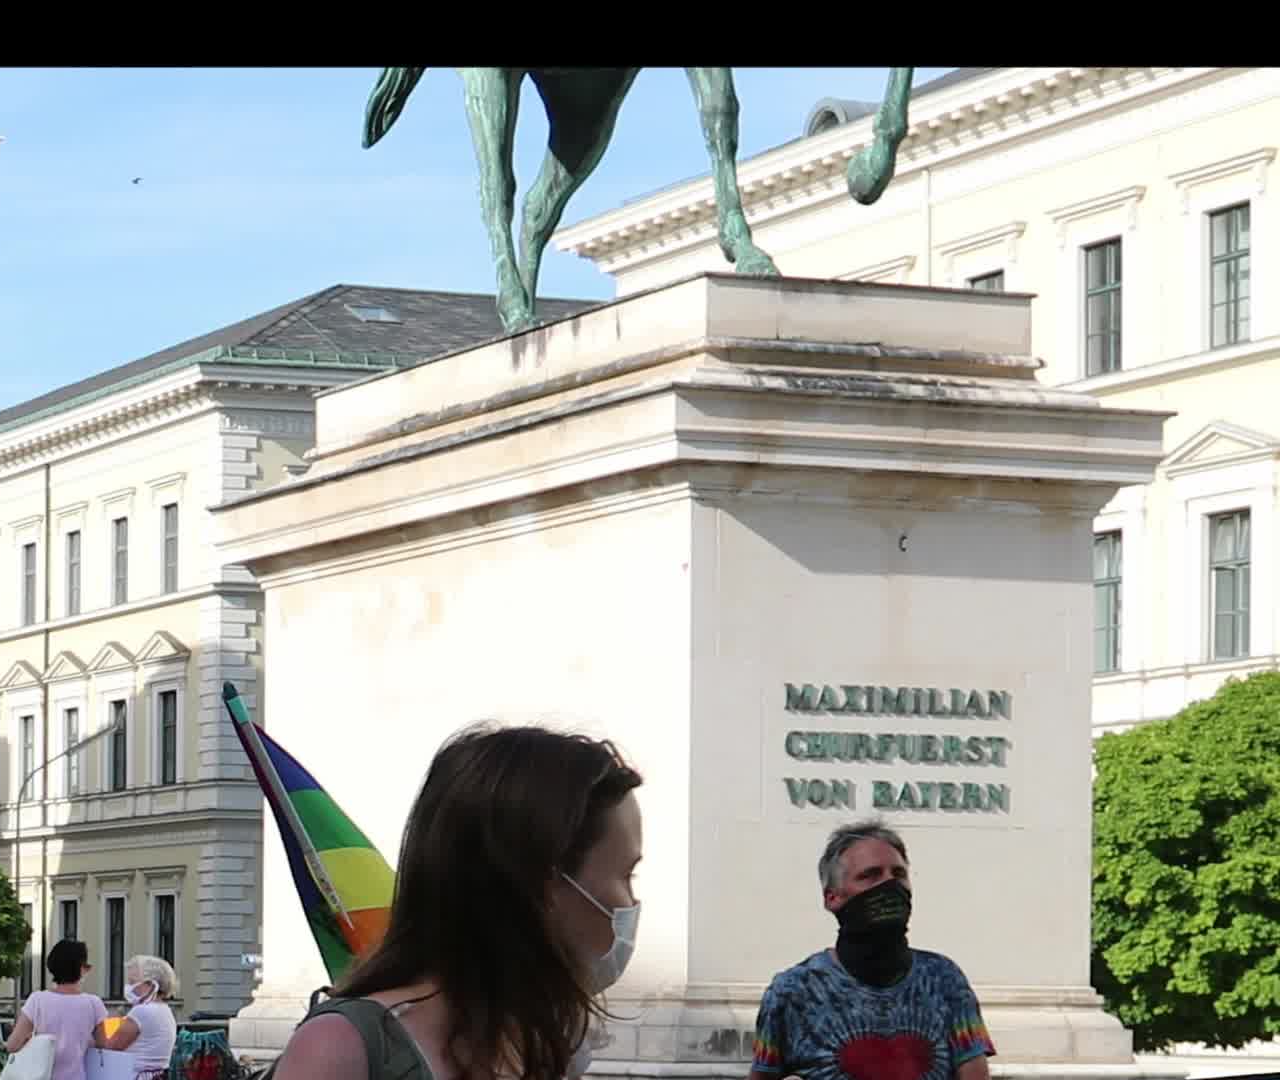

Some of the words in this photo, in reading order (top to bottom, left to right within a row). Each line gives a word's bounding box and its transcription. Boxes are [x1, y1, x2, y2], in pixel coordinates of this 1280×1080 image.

[784, 683, 1010, 718] MAXIMILIAN
[785, 731, 1010, 766] CHURFUERST
[783, 777, 854, 810] VON
[872, 780, 1010, 813] BAYERN
